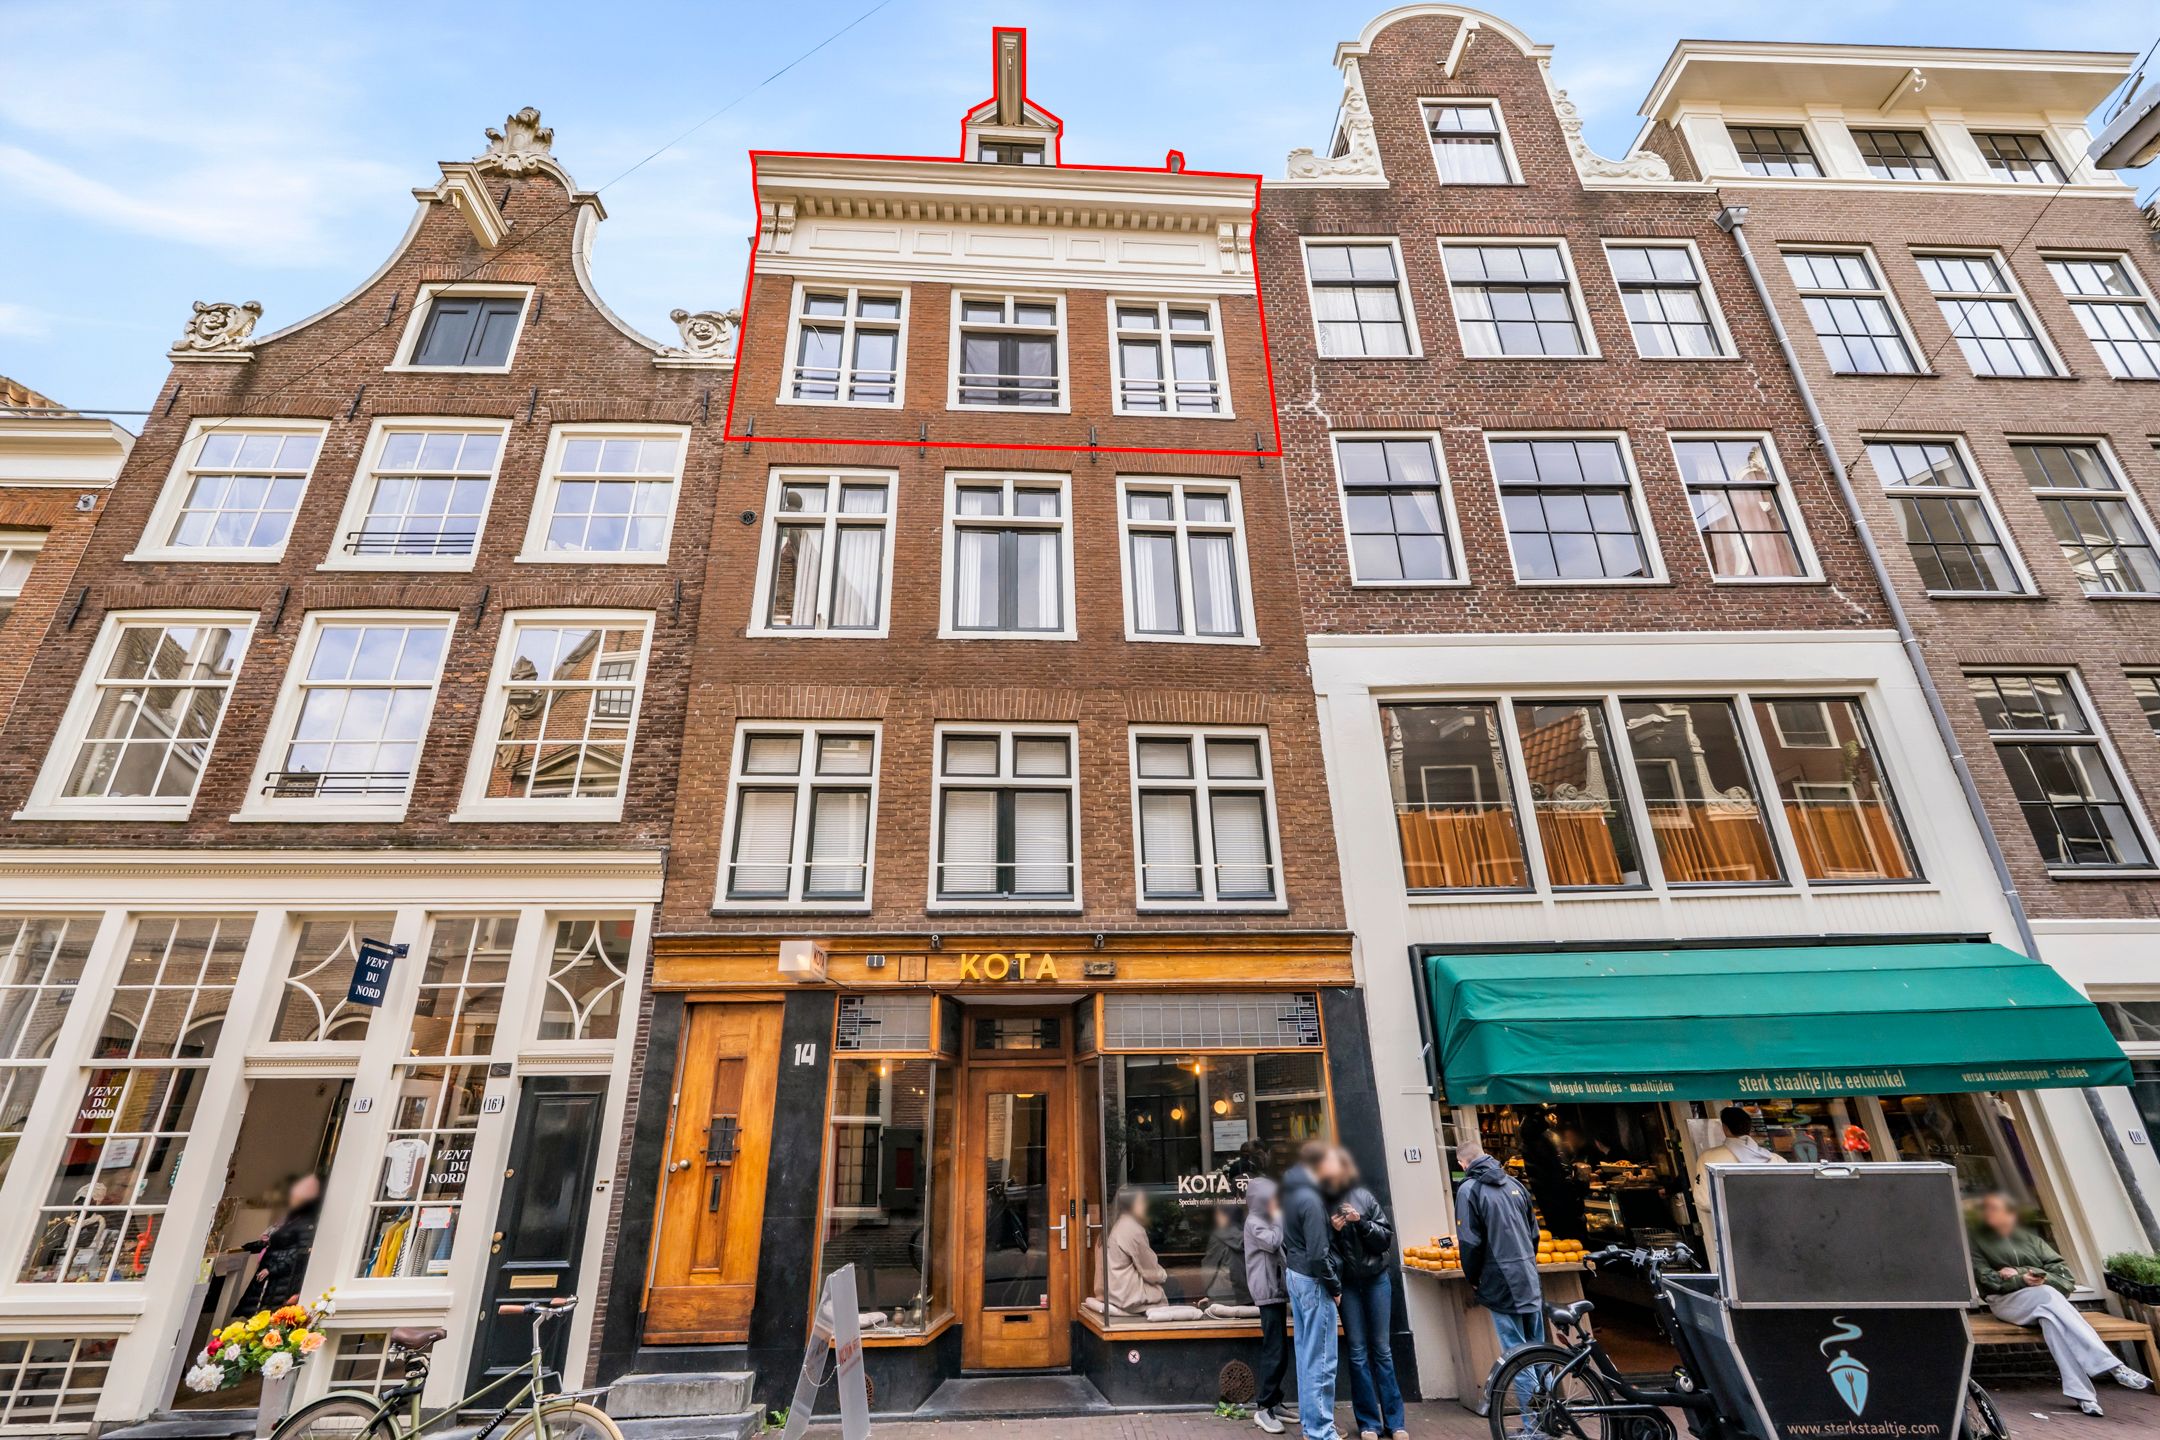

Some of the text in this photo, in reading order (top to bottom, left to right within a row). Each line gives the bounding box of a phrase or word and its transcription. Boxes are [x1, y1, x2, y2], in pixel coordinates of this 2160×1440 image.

[365, 956, 388, 970] VENT
[959, 953, 1059, 980] KOTA
[366, 972, 379, 983] DU
[355, 985, 380, 999] NORD
[794, 1043, 816, 1066] 14
[1738, 1073, 1772, 1092] sterk
[1845, 1069, 1907, 1089] eetwinkel
[1961, 1071, 1985, 1083] verse
[2056, 1065, 2089, 1079] salades
[87, 1086, 122, 1097] VENT
[1549, 1081, 1584, 1096] belegde
[1585, 1080, 1622, 1096] broodjes
[1630, 1079, 1674, 1095] maaltijden
[92, 1097, 111, 1108] DU
[358, 1098, 367, 1111] 16
[78, 1109, 115, 1119] NORD
[436, 1149, 471, 1160] VENT
[1409, 1149, 1417, 1161] 12
[449, 1161, 469, 1172] DU
[429, 1173, 466, 1184] NORD
[1178, 1174, 1231, 1194] KOTA
[1178, 1198, 1199, 1208] Specialty
[1786, 1420, 1940, 1438] www.sterkstaaltje.com
